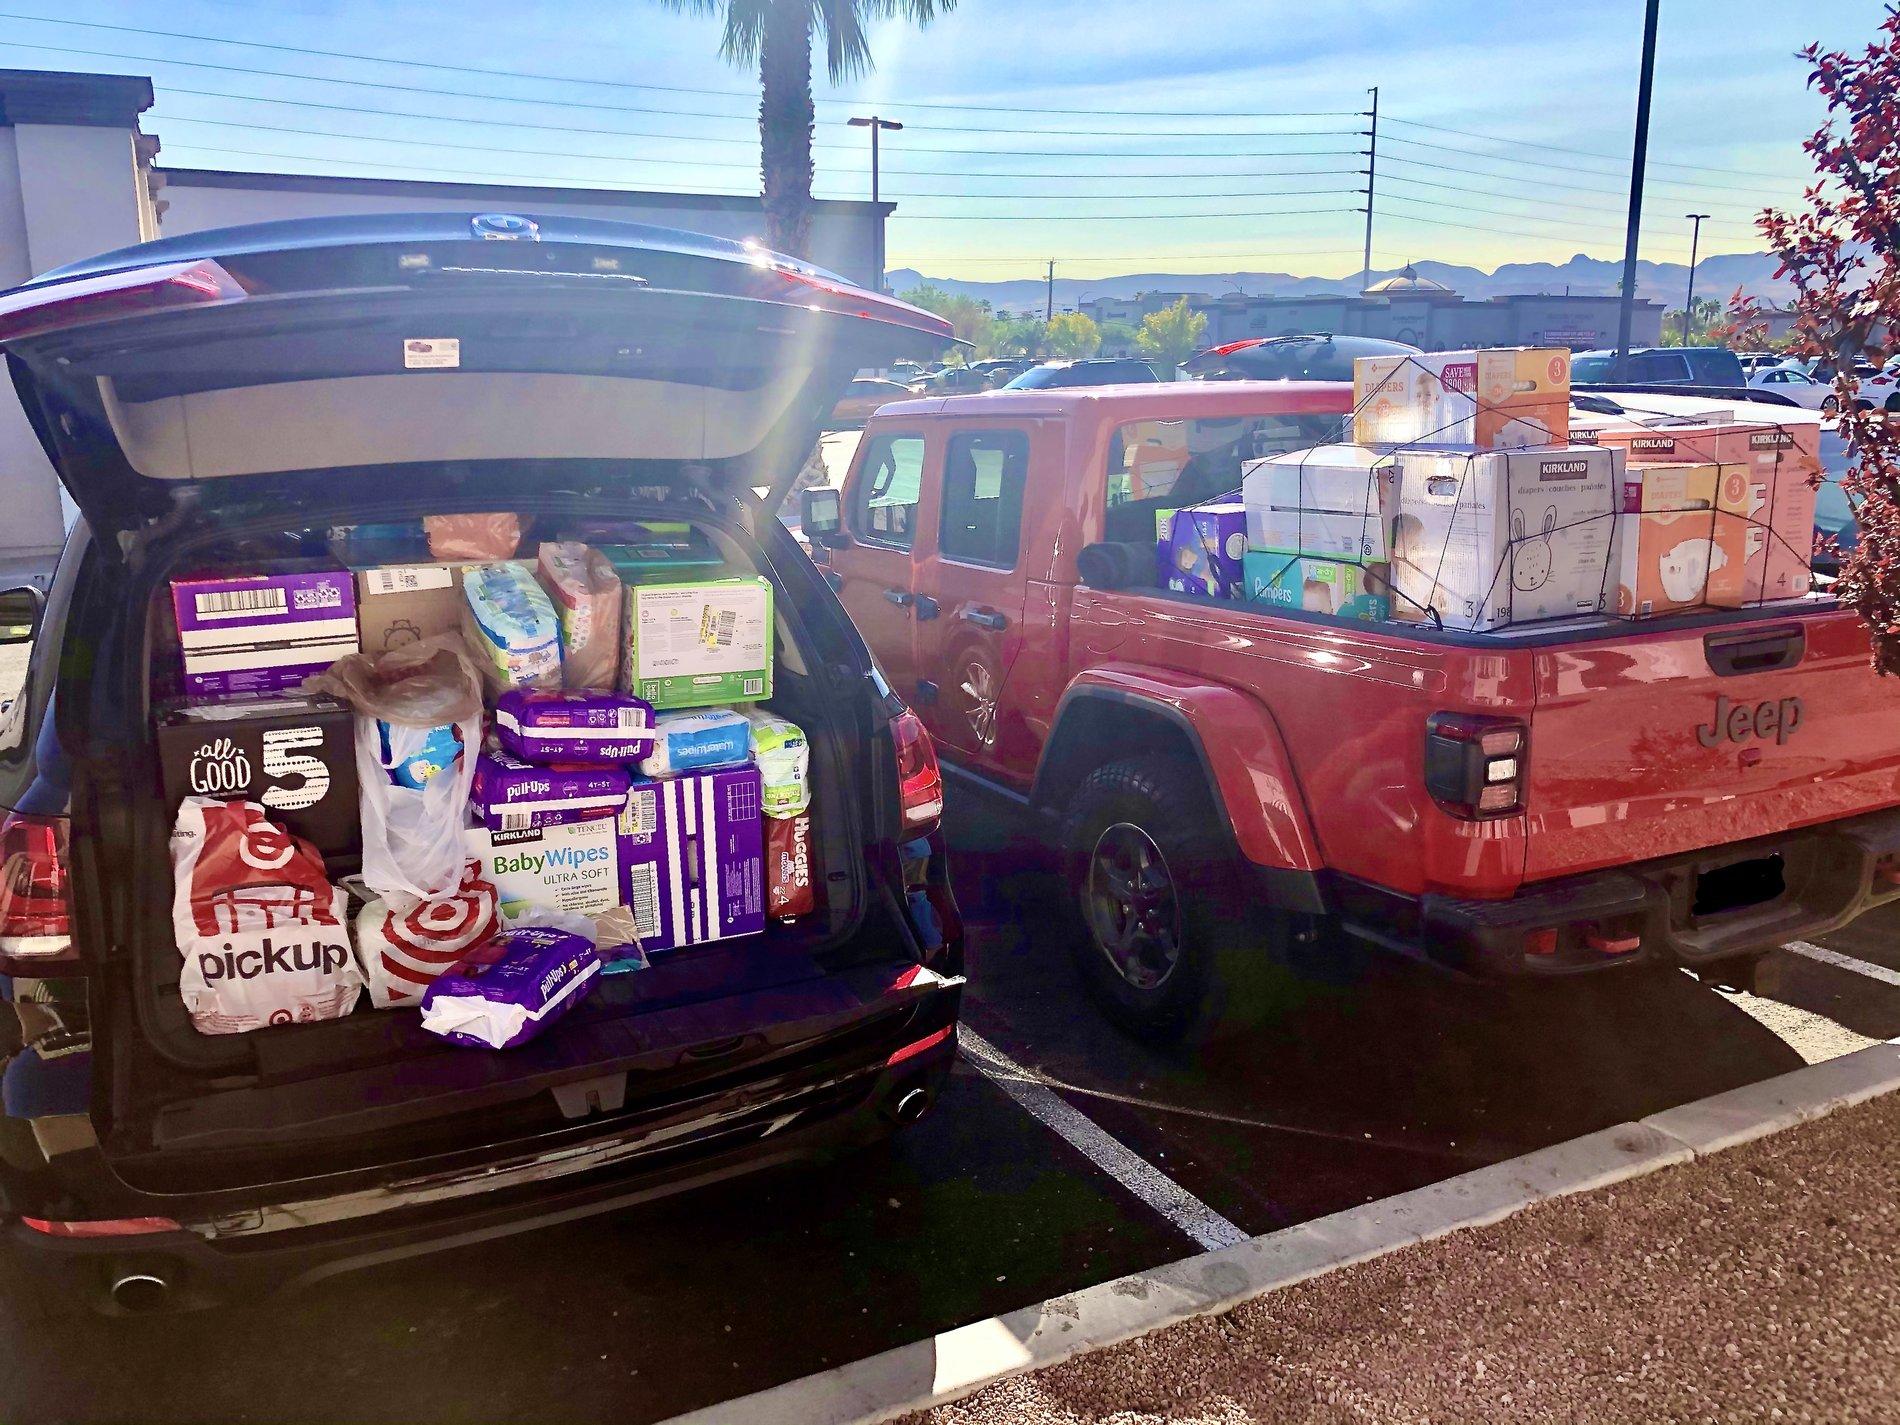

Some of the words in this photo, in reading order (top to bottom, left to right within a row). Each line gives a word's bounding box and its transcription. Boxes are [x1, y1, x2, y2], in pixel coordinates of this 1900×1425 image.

[1445, 367, 1464, 378] SAVE
[1553, 361, 1561, 377] 3
[1570, 431, 1600, 440] KIRKLAN
[1632, 438, 1674, 449] KIRKLAND
[1542, 461, 1587, 475] KIRKLAND
[1731, 479, 1740, 496] 3
[1777, 571, 1786, 587] 4
[1463, 601, 1474, 618] 3
[1695, 694, 1805, 748] Jeep
[200, 738, 236, 761] all
[190, 755, 252, 793] GOOD
[261, 727, 331, 811] 5
[493, 829, 542, 842] KIRKLAND
[543, 873, 578, 886] ULTRA
[581, 866, 610, 880] SOFT
[198, 938, 348, 988] pickup
